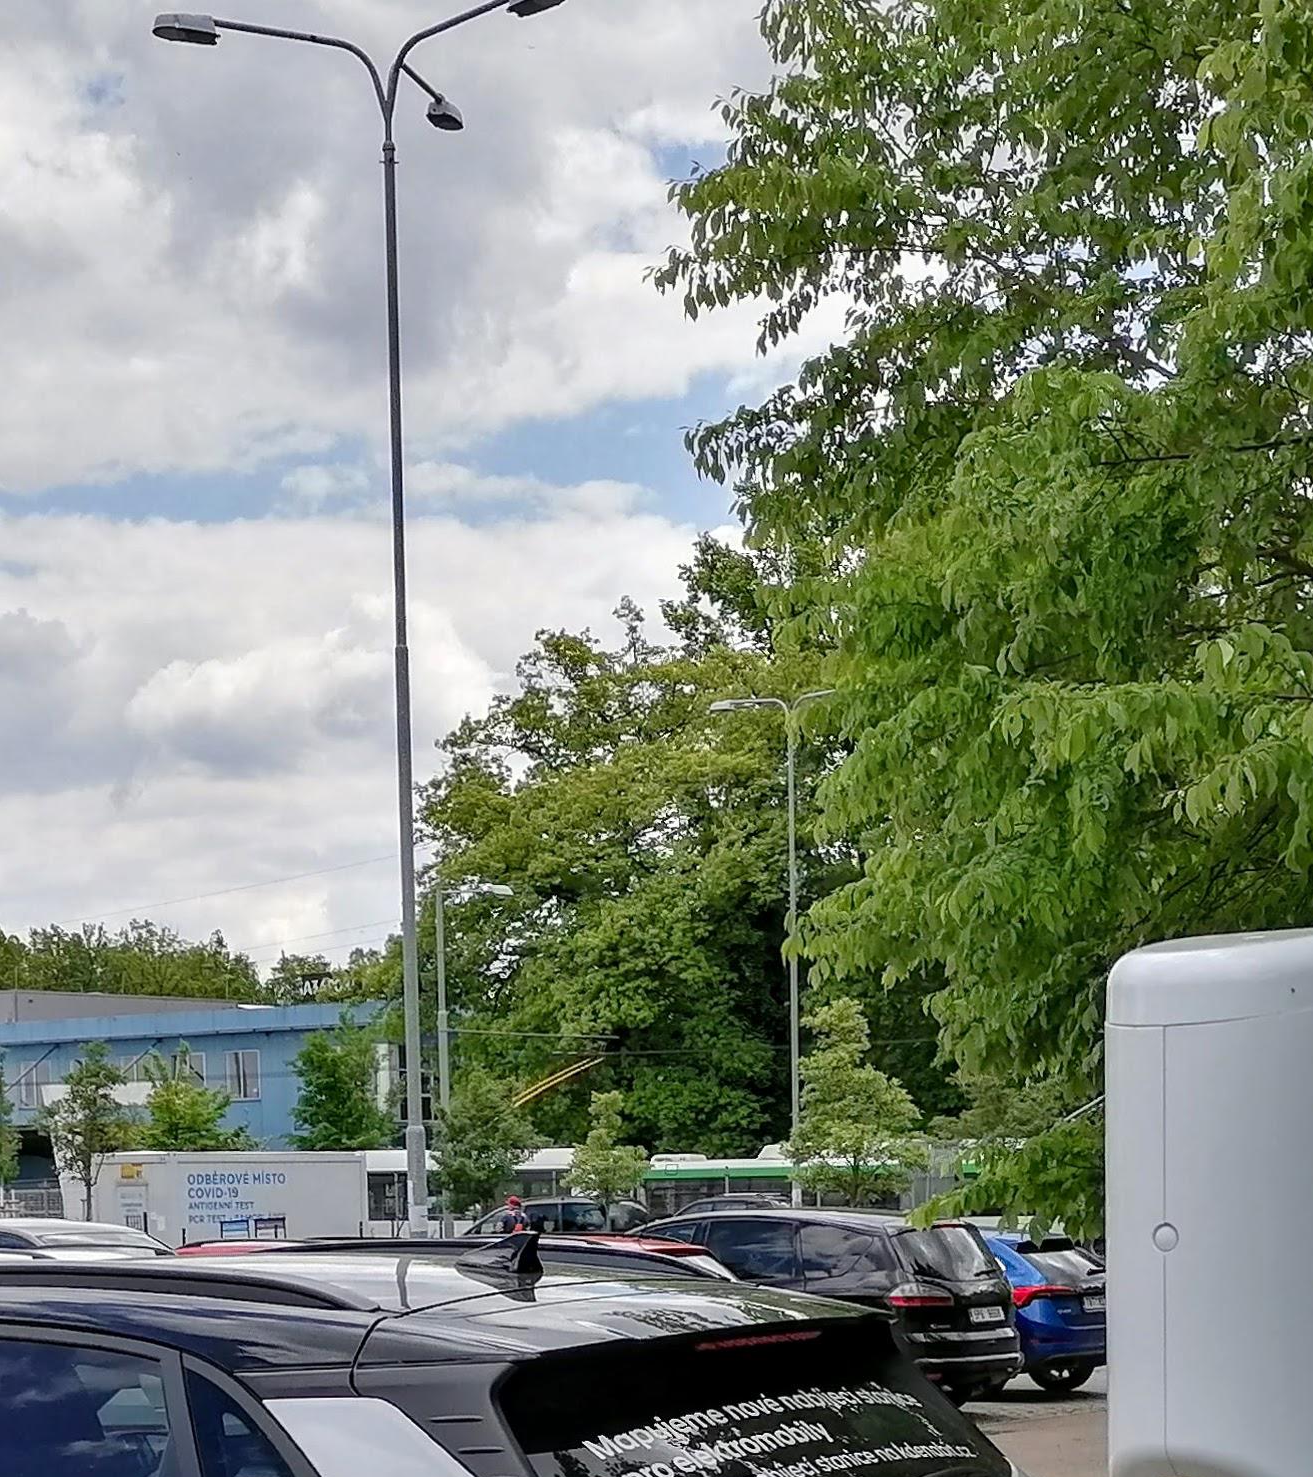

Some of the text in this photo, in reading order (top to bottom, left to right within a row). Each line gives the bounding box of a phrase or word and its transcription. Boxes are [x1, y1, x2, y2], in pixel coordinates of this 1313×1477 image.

[187, 1170, 286, 1185] ODBĚROVÉ MÍSTO
[187, 1186, 239, 1199] COVID-19
[235, 1201, 254, 1210] TEST
[582, 1383, 923, 1460] Mapujeme nové nabíjecí stanice
[672, 1420, 834, 1474] elektromobily
[815, 1448, 879, 1472] stanice
[875, 1445, 900, 1462] na
